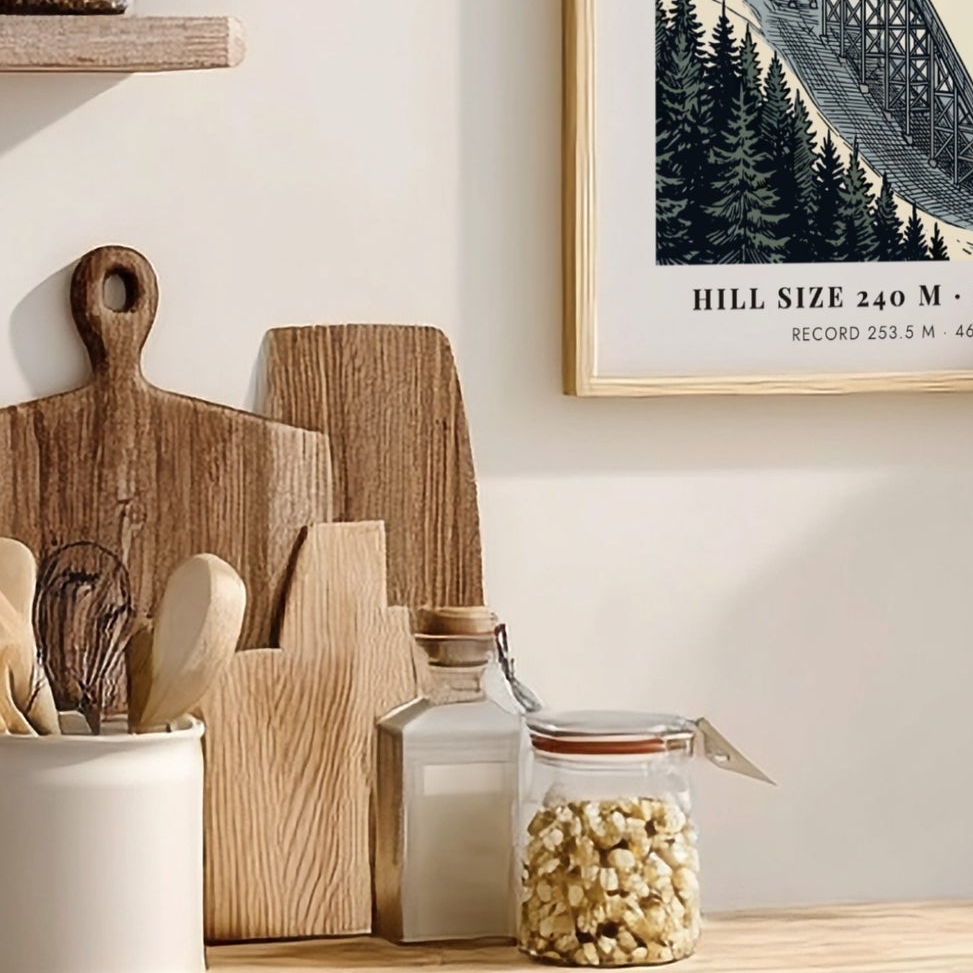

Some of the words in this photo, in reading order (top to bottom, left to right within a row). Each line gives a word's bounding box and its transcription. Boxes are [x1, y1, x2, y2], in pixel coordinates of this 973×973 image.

[692, 288, 765, 311] HILL
[778, 285, 844, 310] SIZE
[857, 290, 906, 312] 240
[919, 284, 942, 307] M
[792, 325, 860, 342] RECORD
[868, 324, 914, 341] 253.5
[922, 324, 936, 339] M
